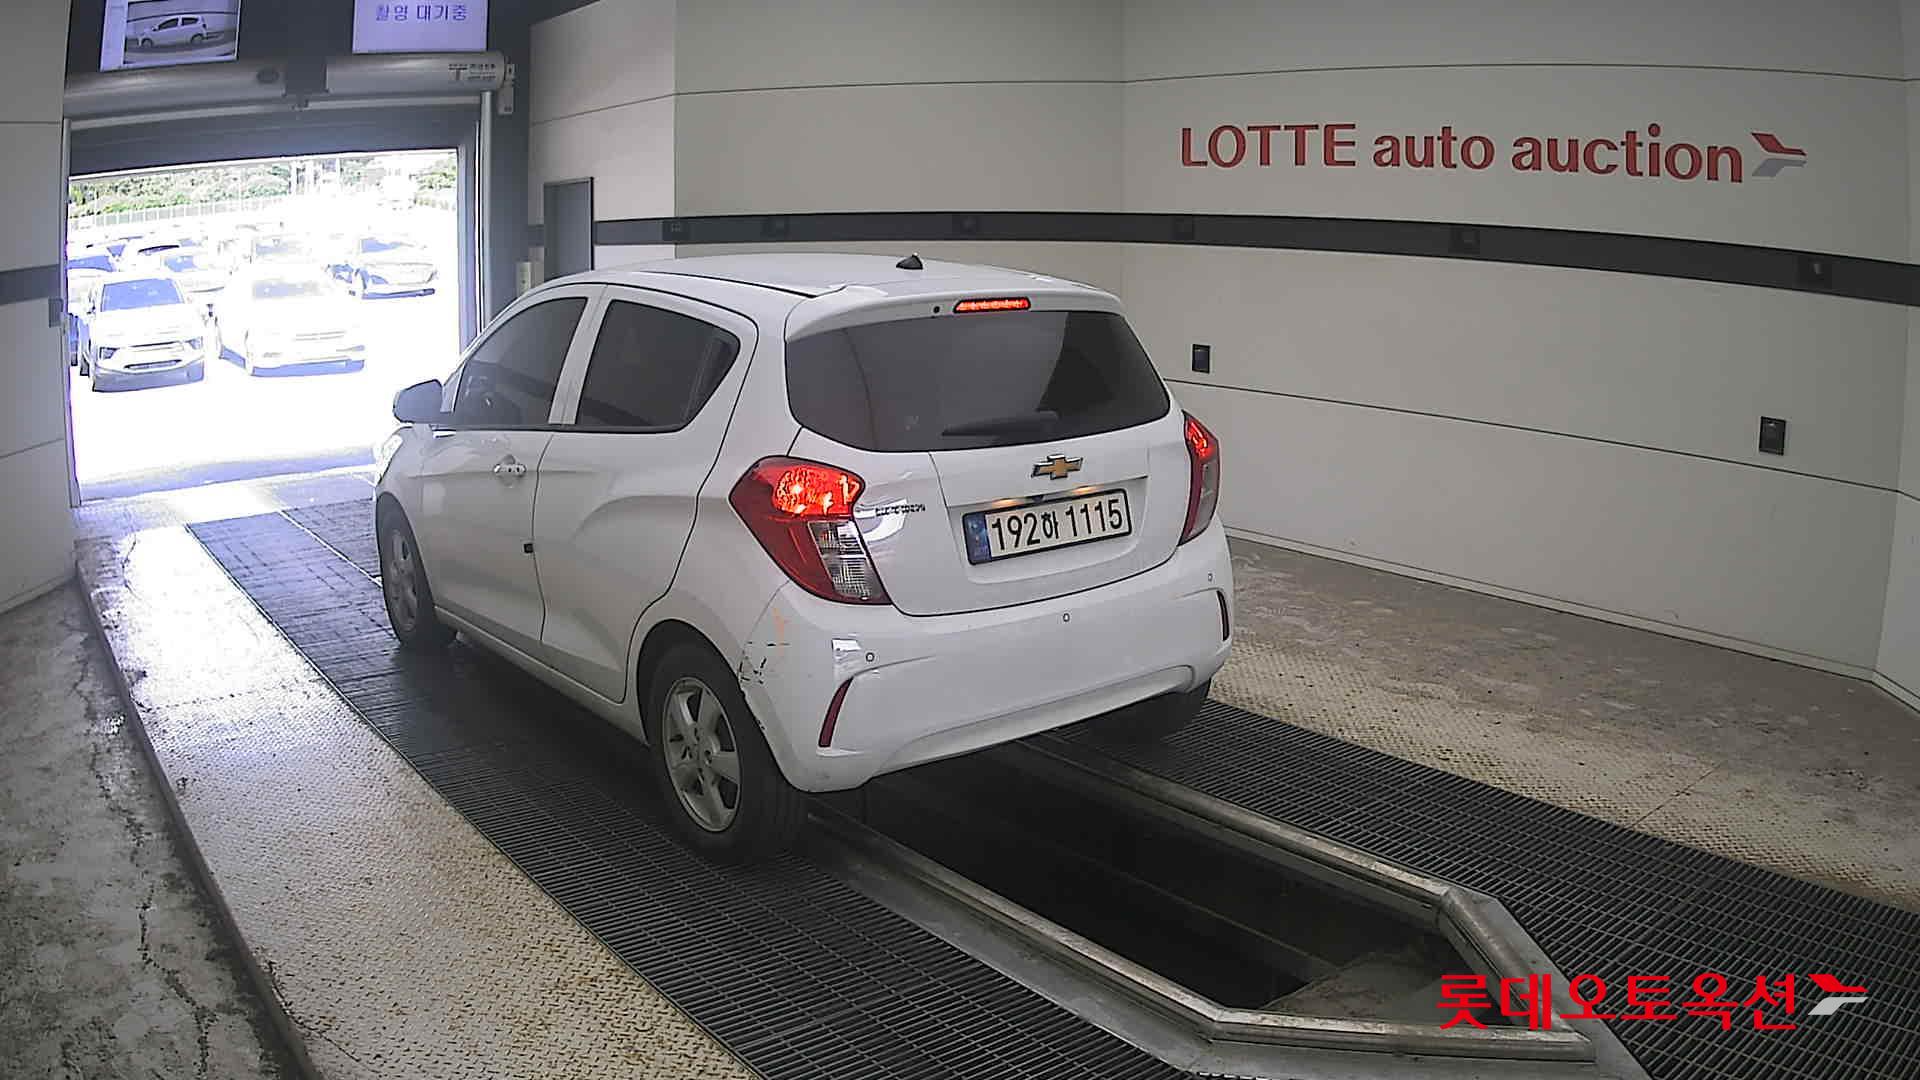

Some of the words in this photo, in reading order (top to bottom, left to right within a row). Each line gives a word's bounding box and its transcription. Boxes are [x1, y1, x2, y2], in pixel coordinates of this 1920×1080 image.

[416, 4, 468, 21] 대기중
[1181, 123, 1356, 168] LOTTE
[1372, 126, 1495, 170] auto
[1511, 123, 1743, 183] auction
[991, 511, 1059, 550] 192하
[1065, 499, 1123, 537] 1115
